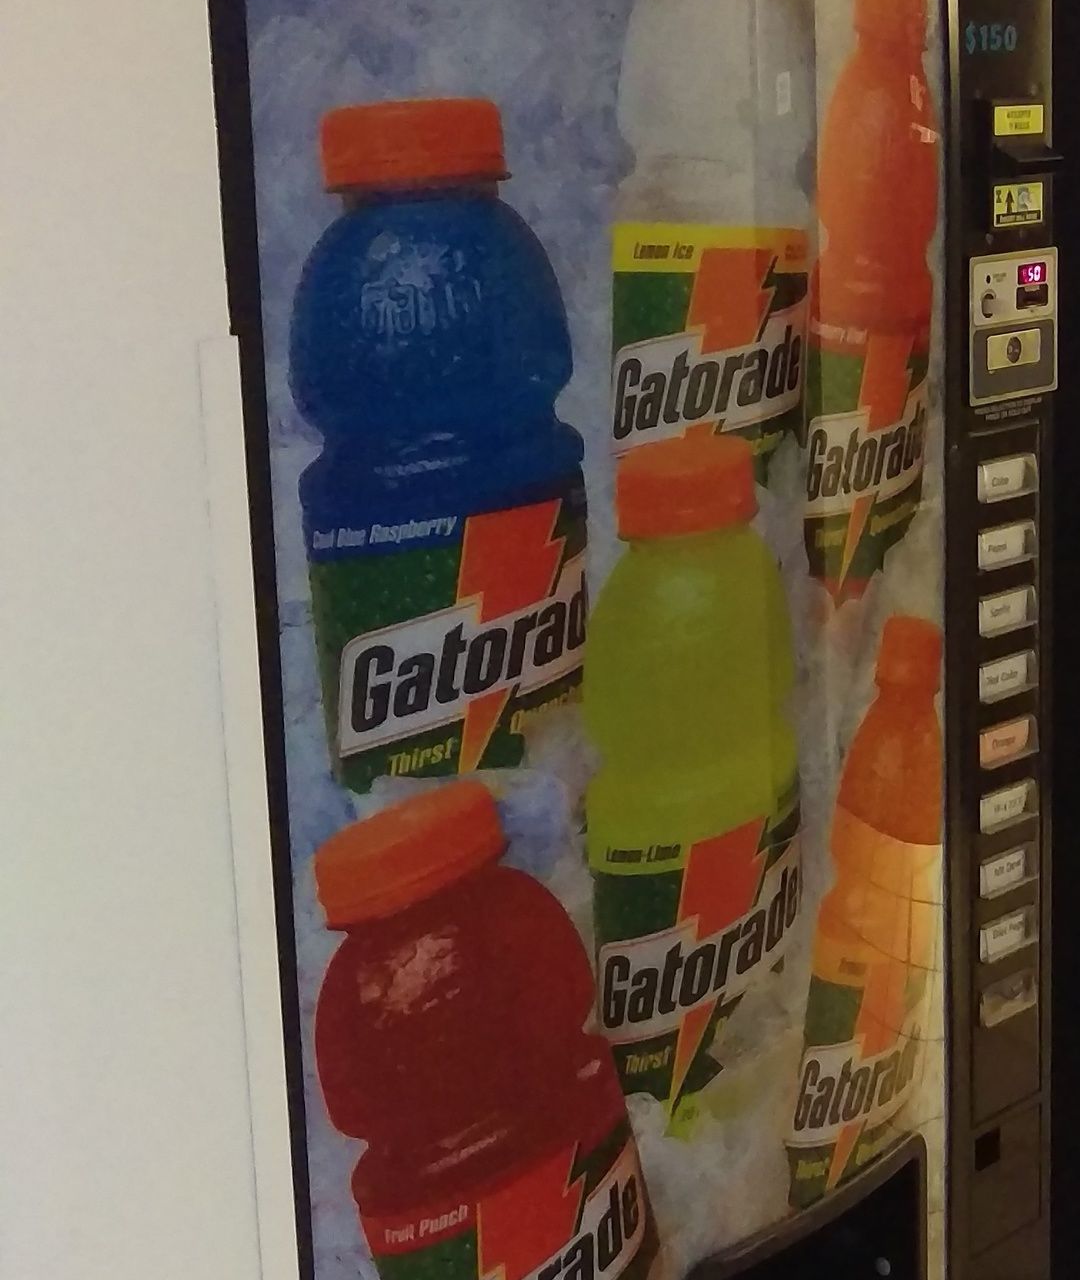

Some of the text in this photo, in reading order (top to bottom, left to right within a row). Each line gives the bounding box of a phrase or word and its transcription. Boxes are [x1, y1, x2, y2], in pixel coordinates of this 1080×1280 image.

[633, 241, 695, 260] Lemon Ice
[612, 324, 801, 440] Gatorade
[368, 515, 458, 545] Raspberry
[350, 568, 590, 734] Gatorad
[387, 736, 459, 777] Thirst
[602, 864, 799, 1030] Gatorade
[624, 1045, 673, 1075] Thirst
[418, 1204, 469, 1238] Punch
